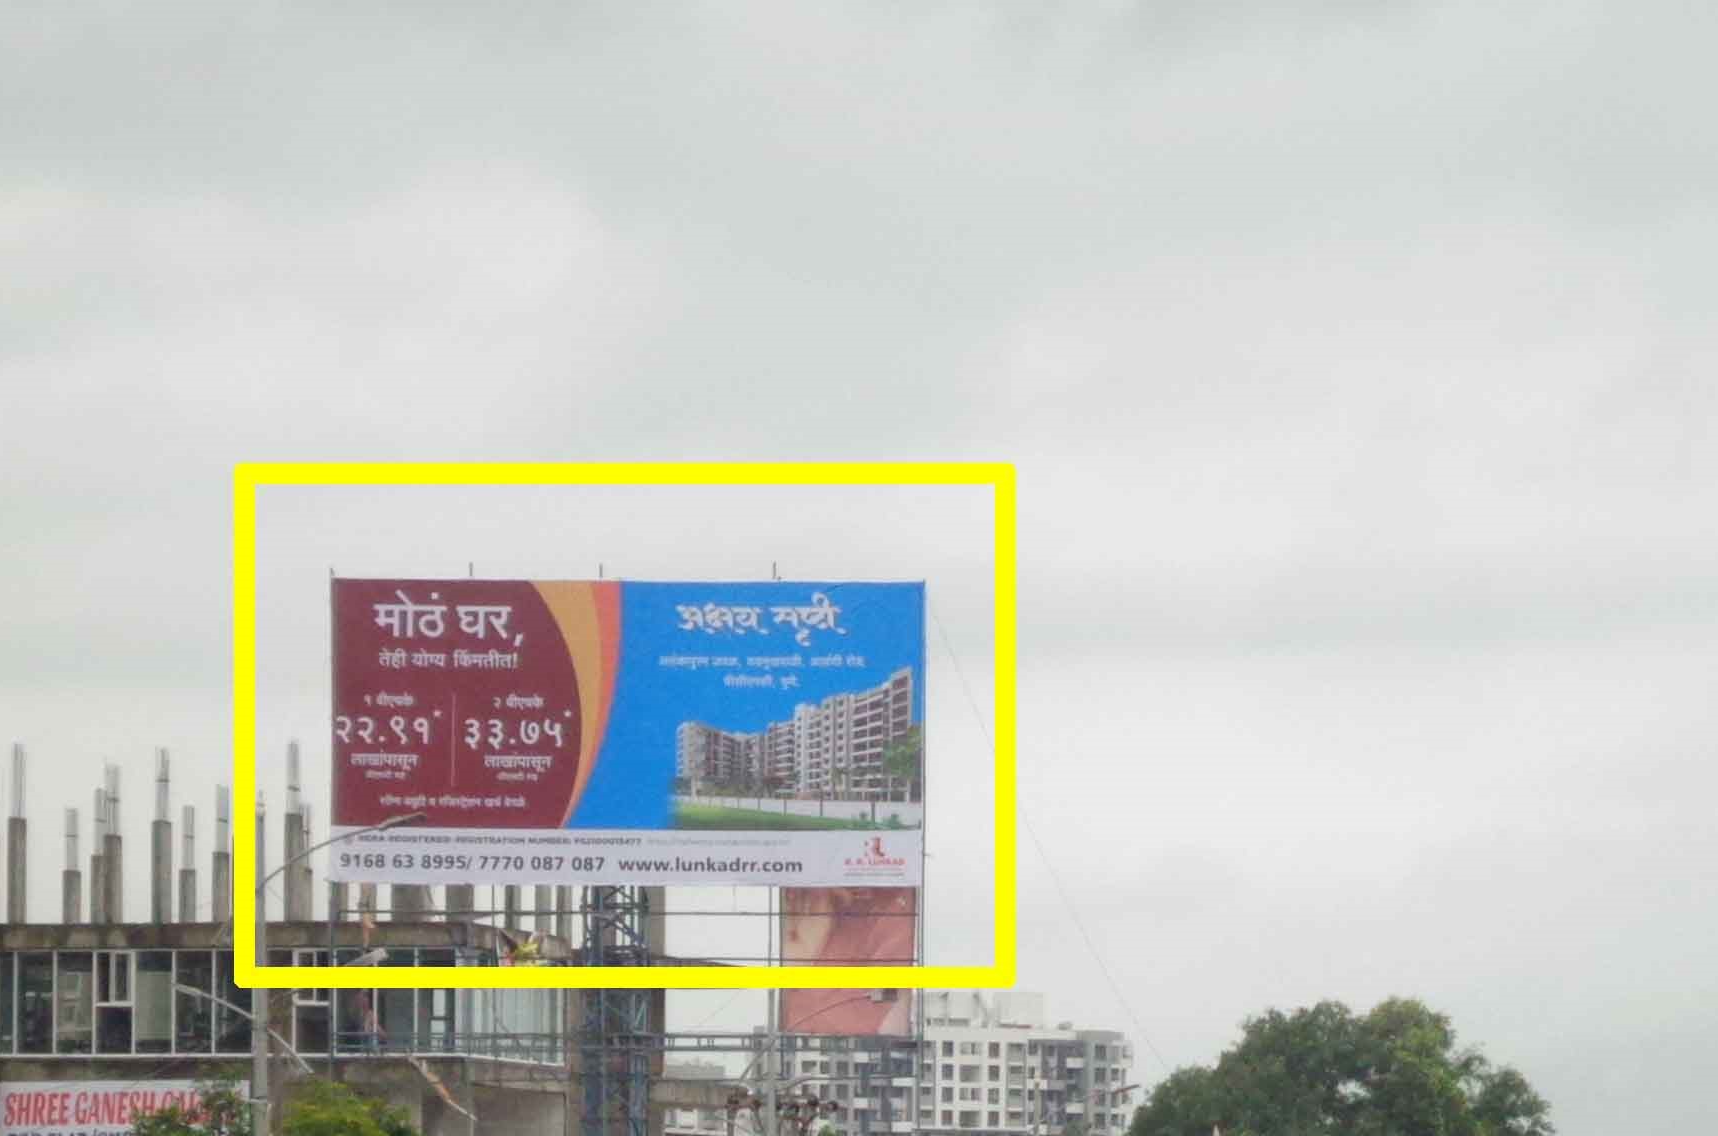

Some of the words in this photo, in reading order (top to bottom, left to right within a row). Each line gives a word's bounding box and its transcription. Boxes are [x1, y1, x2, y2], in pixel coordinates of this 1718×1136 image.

[373, 589, 447, 638] मोठं
[456, 604, 524, 647] घर,
[379, 648, 407, 668] तेही
[411, 648, 444, 668] योग्य
[340, 853, 385, 869] 9168
[392, 854, 414, 869] 63
[421, 854, 472, 871] 8995/
[479, 855, 524, 870] 7770
[531, 856, 564, 871] 087
[572, 856, 605, 872] 087
[618, 856, 803, 873] www.lunkadrr.com
[4, 1091, 72, 1127] SHREE
